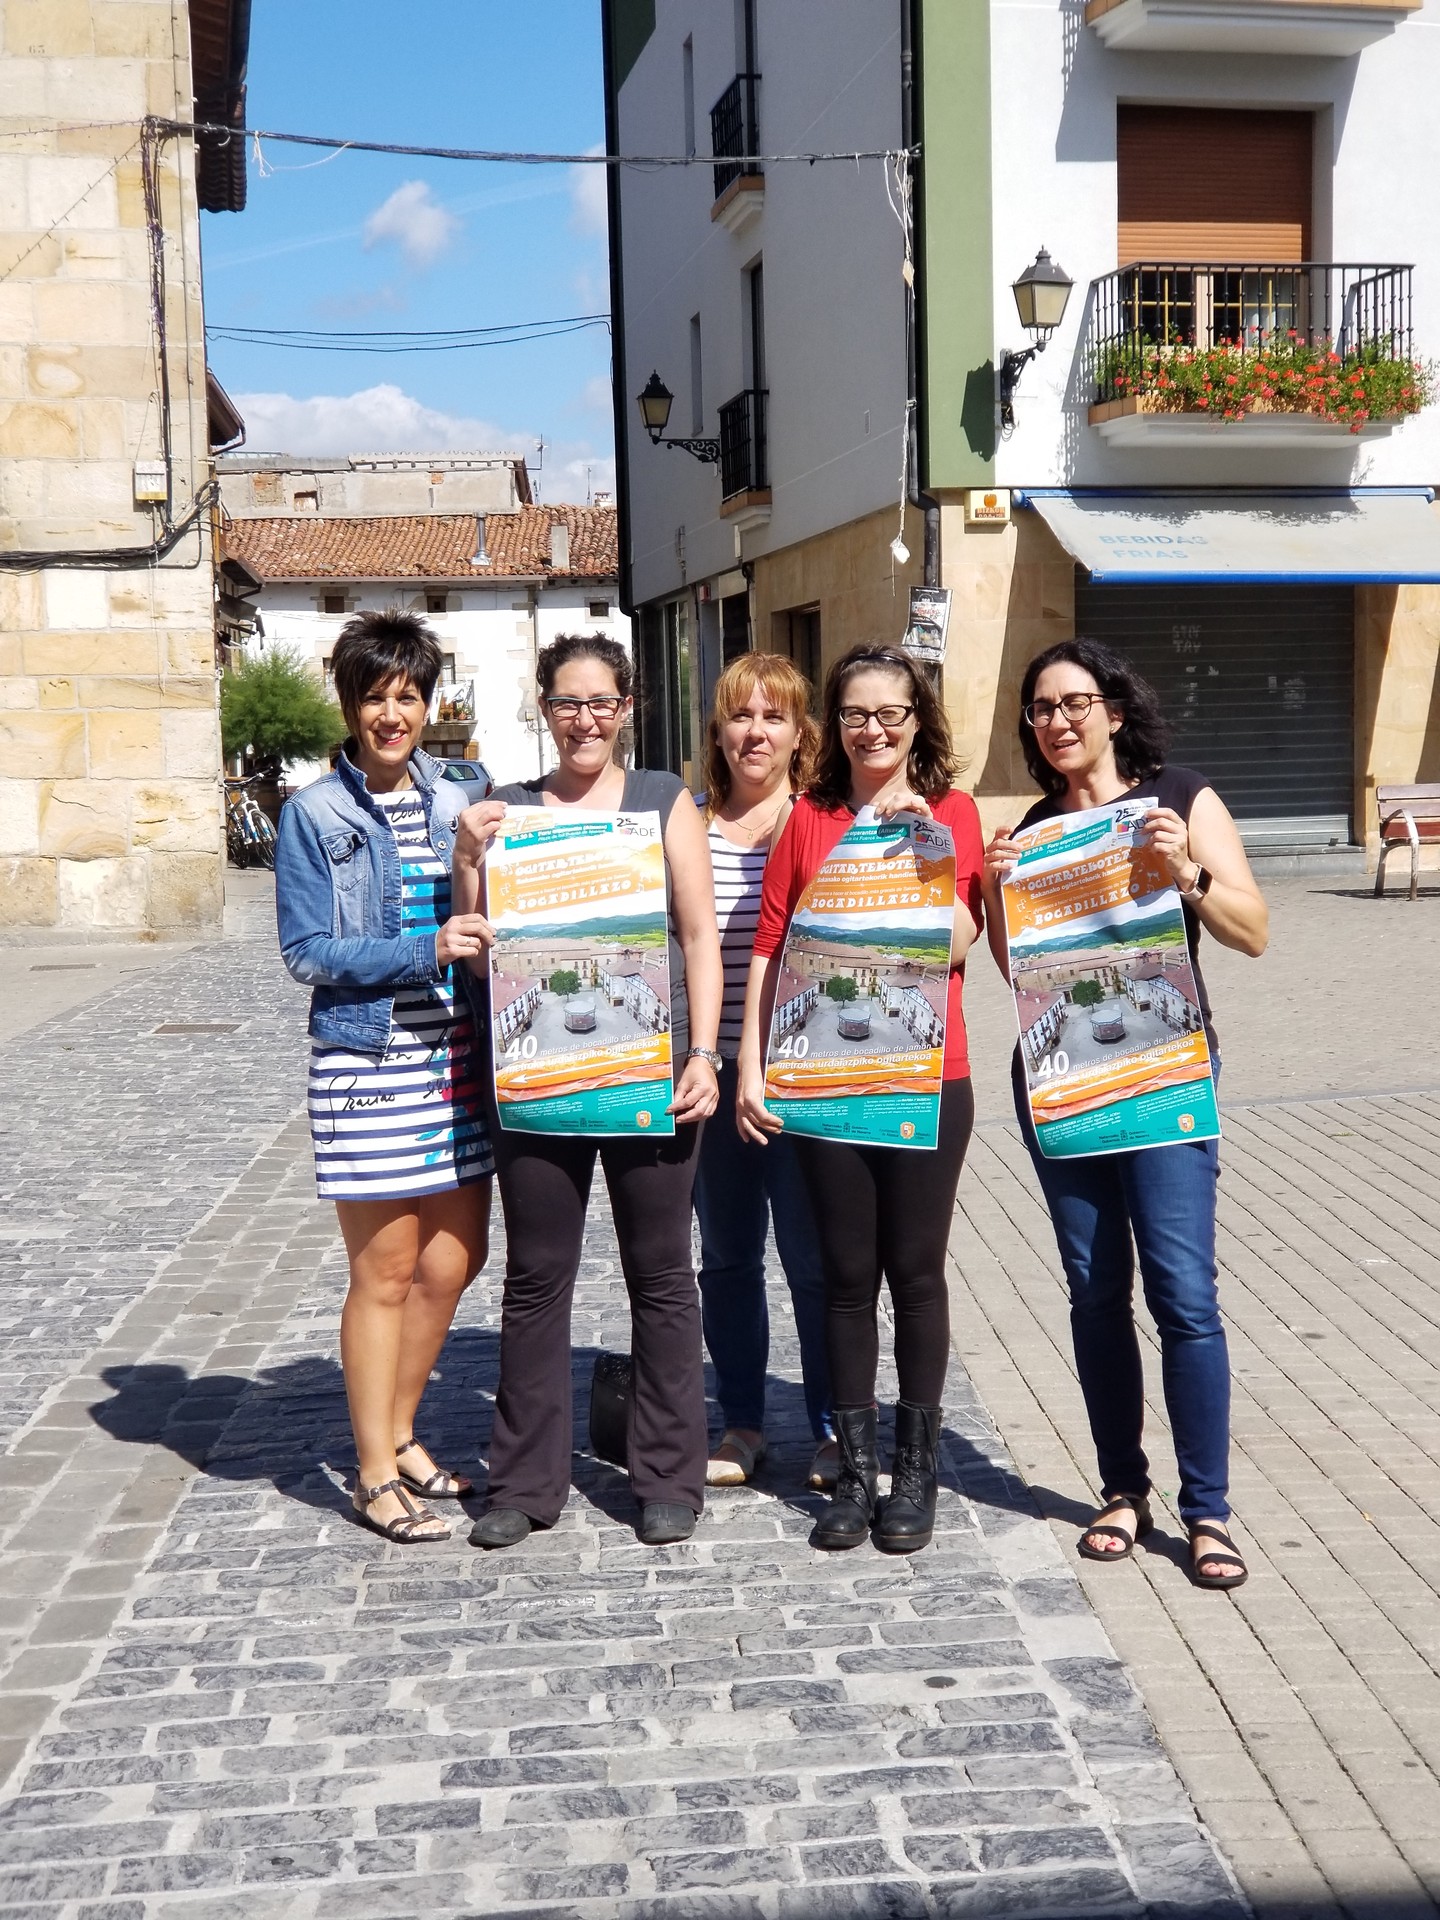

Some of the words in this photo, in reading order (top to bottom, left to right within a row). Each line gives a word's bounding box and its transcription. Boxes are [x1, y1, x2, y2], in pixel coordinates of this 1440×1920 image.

[1098, 535, 1209, 545] BEBIDAS
[1112, 549, 1189, 559] FRIAS
[1115, 807, 1130, 823] 25
[913, 820, 929, 832] 25
[926, 834, 951, 849] ADE
[811, 893, 921, 909] BOCADILLAZO
[1034, 883, 1140, 925] BOCADILLAZO
[505, 1034, 538, 1062] 40
[540, 1046, 568, 1057] metros
[570, 1043, 581, 1051] de
[582, 1034, 619, 1049] bocadillo
[621, 1032, 632, 1042] de
[633, 1028, 659, 1041] jamón
[777, 1035, 810, 1059] 40
[811, 1050, 839, 1058] metros
[841, 1048, 852, 1057] de
[854, 1045, 891, 1056] bocadillo
[893, 1044, 904, 1053] de
[905, 1043, 932, 1053] jamón
[777, 1061, 816, 1070] metroko
[876, 1052, 932, 1065] ogitartekoa
[1037, 1050, 1070, 1079] 40
[1073, 1057, 1101, 1071] metros
[1103, 1053, 1113, 1063] de
[1115, 1041, 1152, 1059] bocadillo
[1153, 1036, 1164, 1046] de
[1165, 1029, 1192, 1044] jamón
